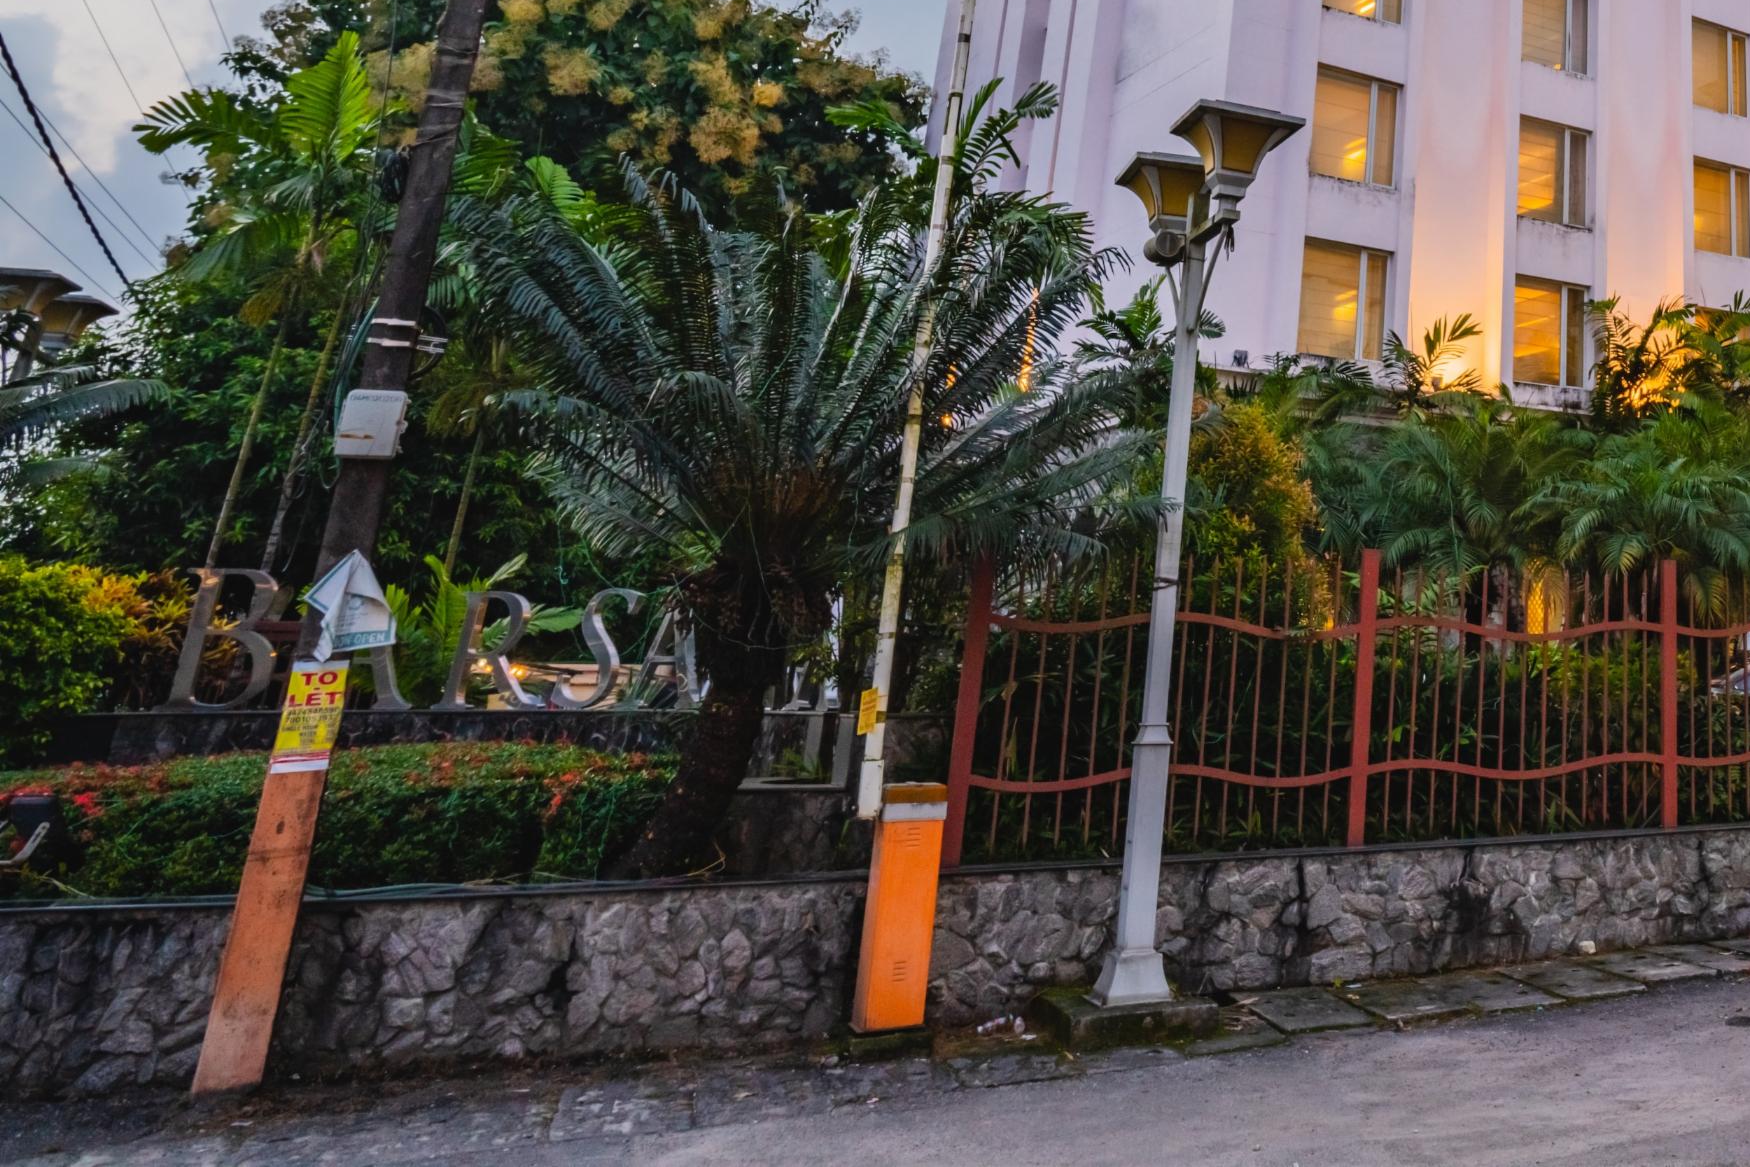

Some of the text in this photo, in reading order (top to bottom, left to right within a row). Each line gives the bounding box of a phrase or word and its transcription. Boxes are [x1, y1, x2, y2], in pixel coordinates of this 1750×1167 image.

[354, 632, 385, 644] OPEN
[301, 671, 338, 686] TO
[288, 692, 341, 707] LET
